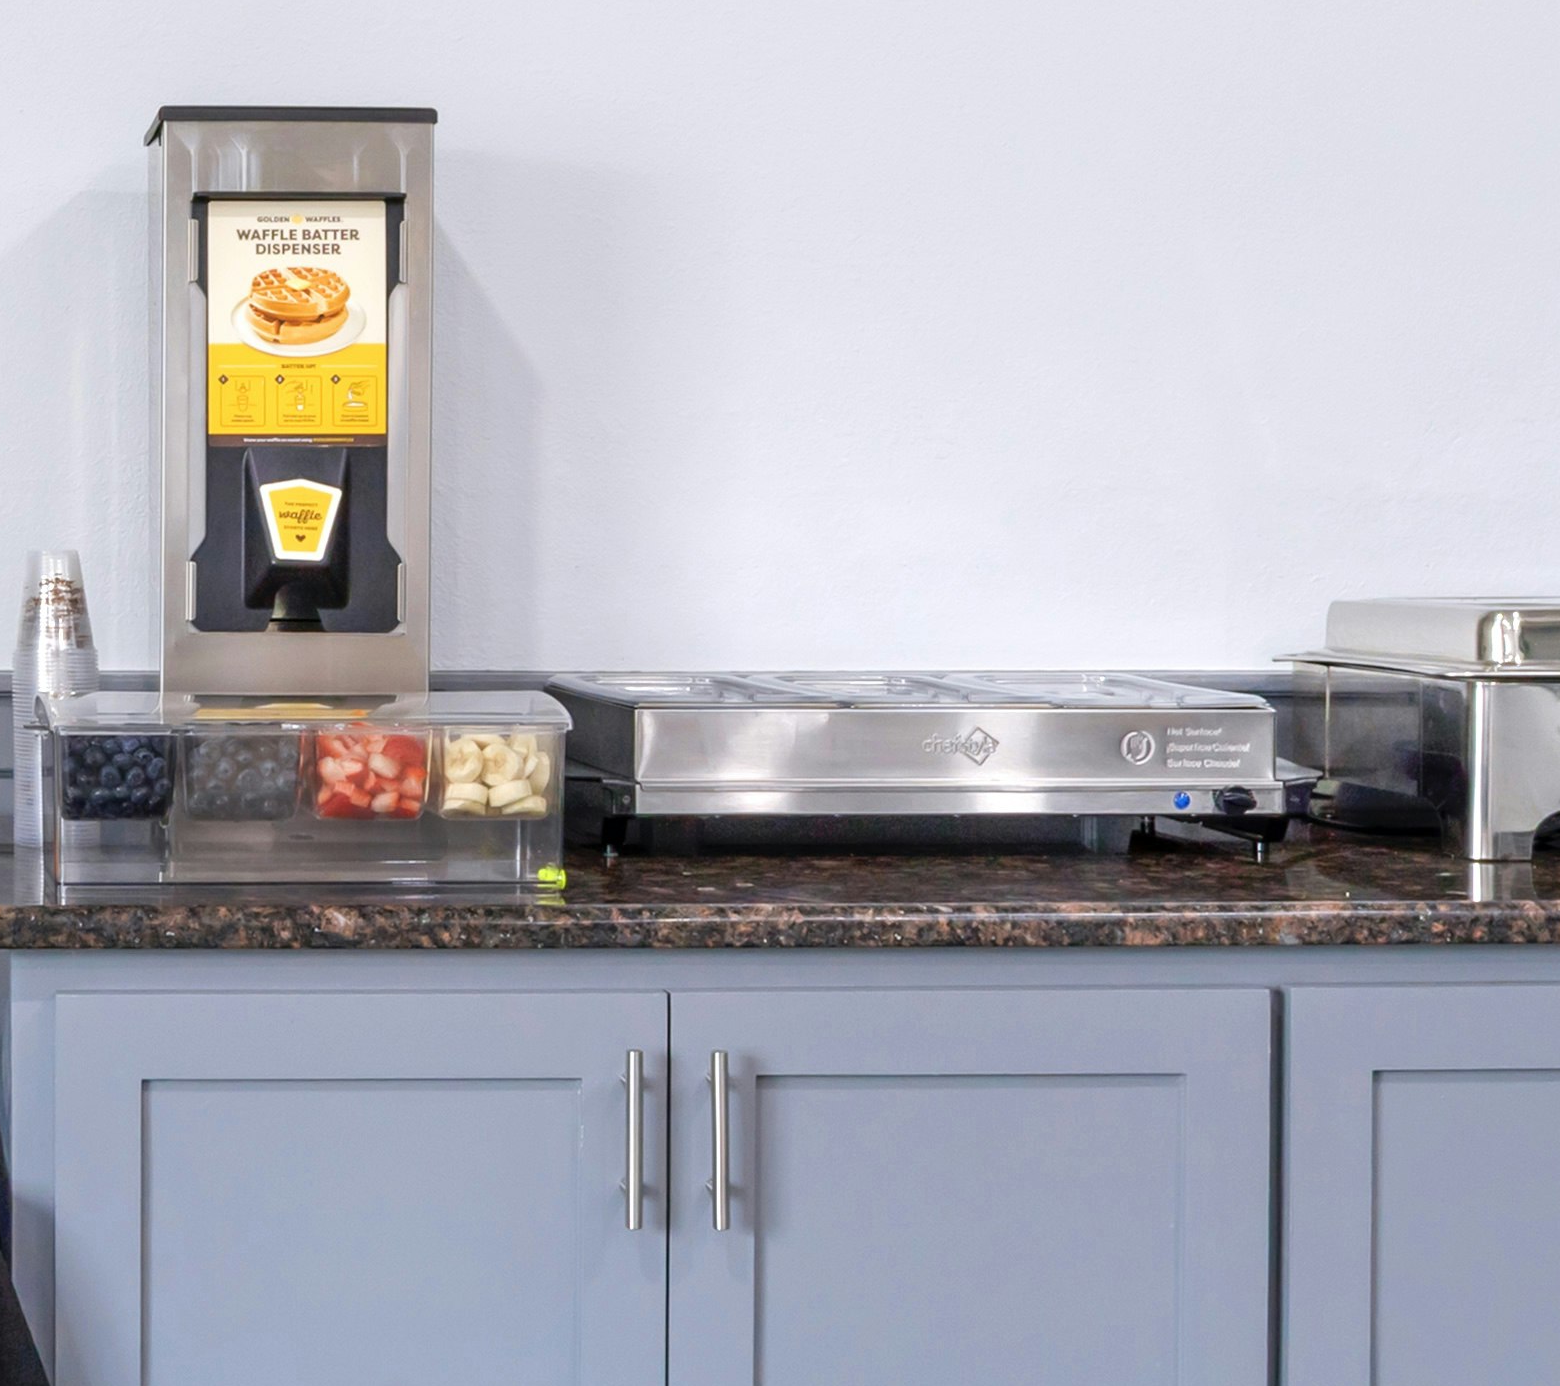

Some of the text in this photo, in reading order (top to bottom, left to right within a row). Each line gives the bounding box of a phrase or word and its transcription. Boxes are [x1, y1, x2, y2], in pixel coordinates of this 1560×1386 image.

[236, 229, 360, 241] WAFFLE BATTER
[255, 243, 341, 255] DISPENSER
[279, 509, 323, 524] waffle
